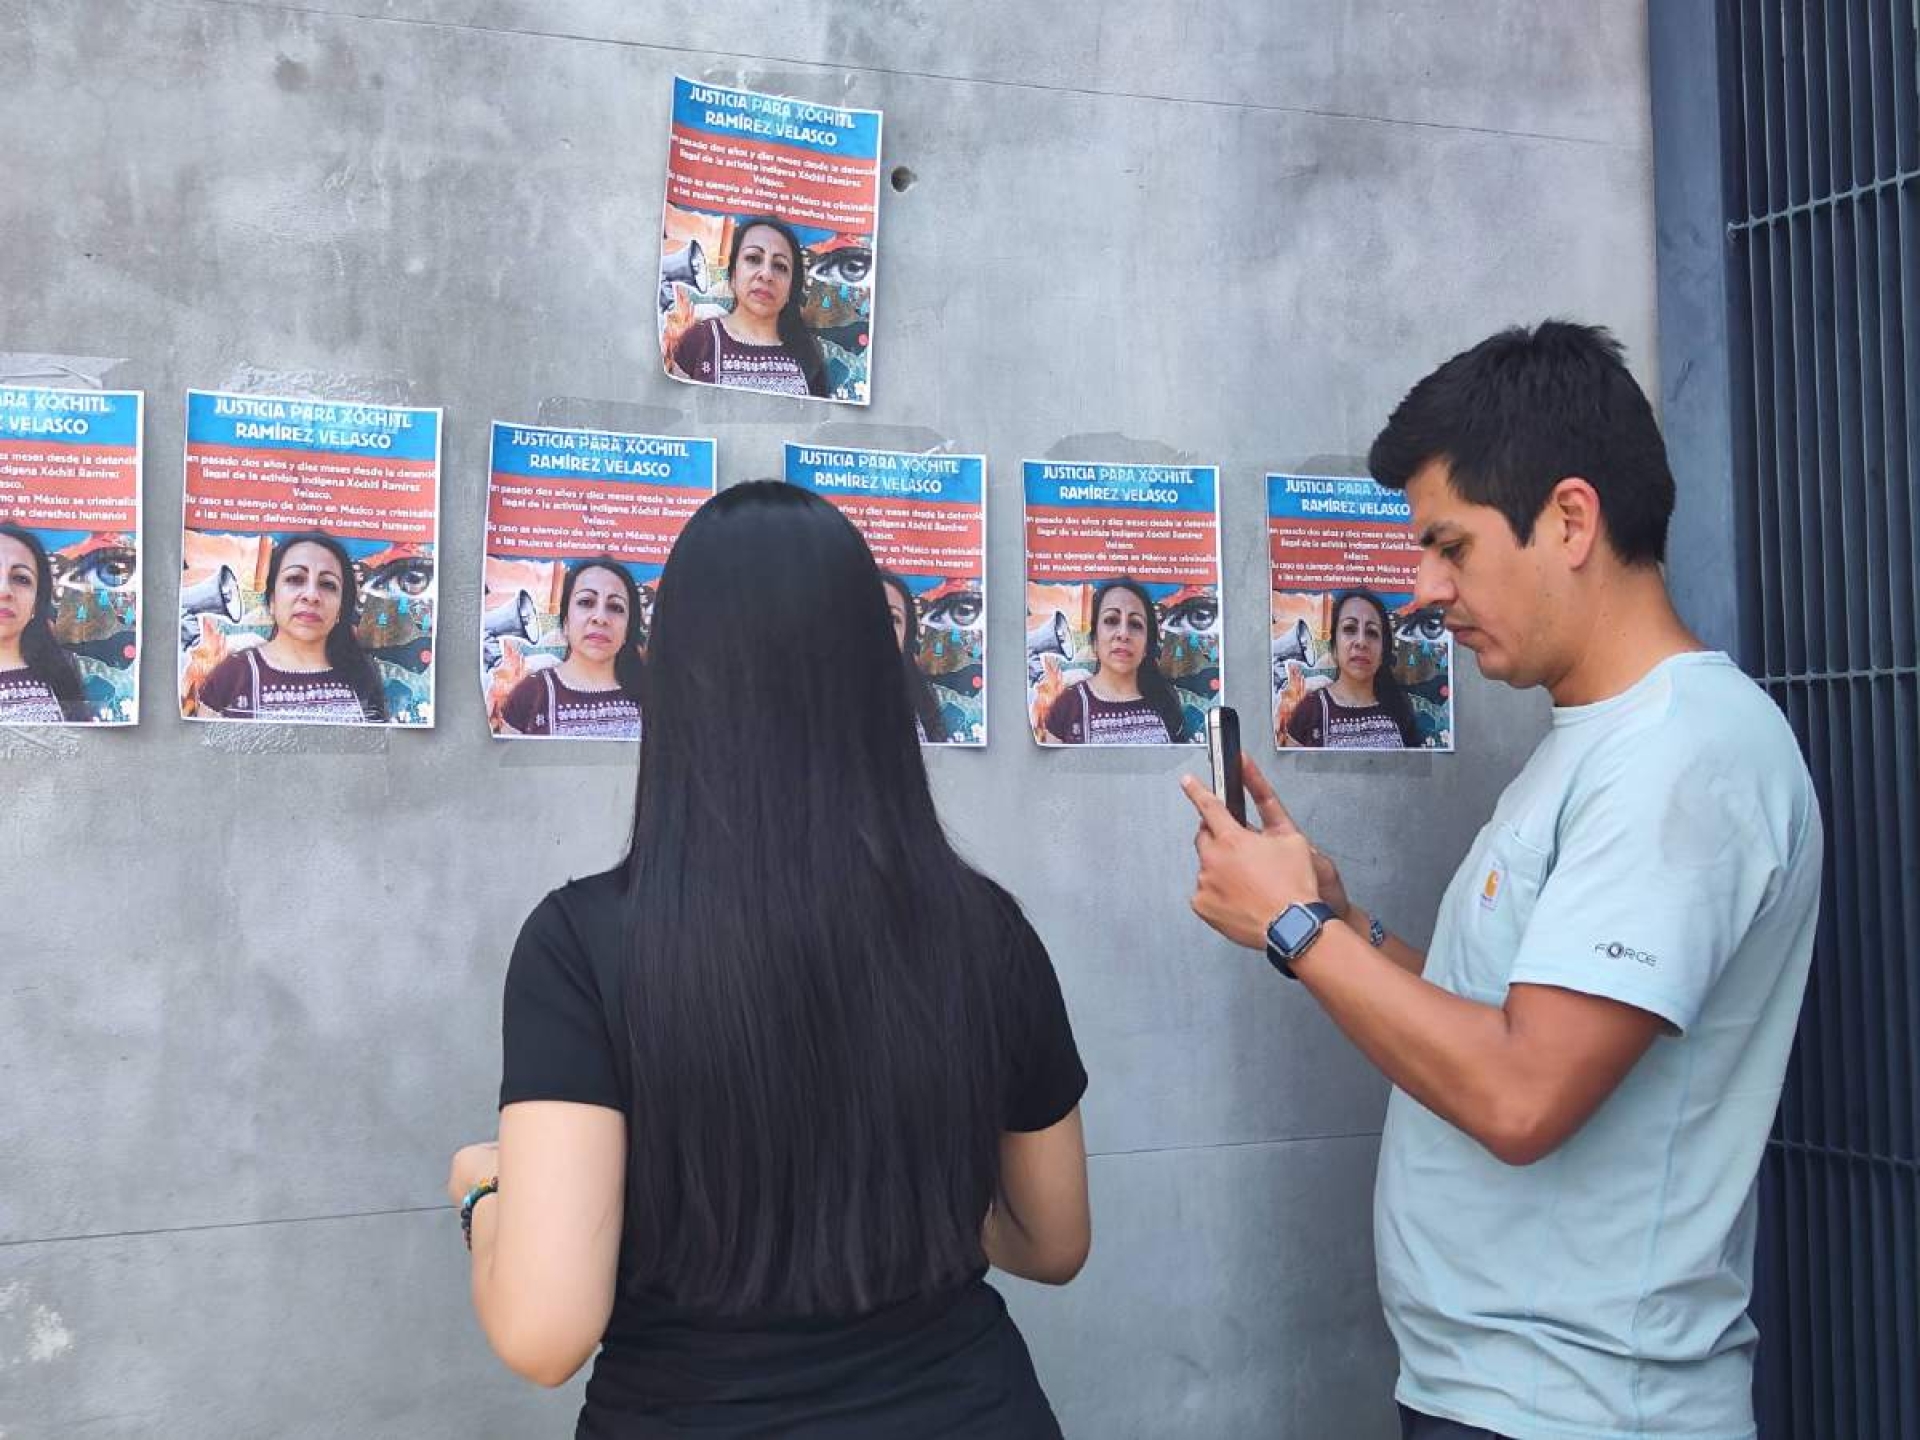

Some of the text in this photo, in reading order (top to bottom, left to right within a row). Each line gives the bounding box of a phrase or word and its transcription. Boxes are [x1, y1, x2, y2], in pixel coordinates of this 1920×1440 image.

[690, 85, 747, 109] JUSTICIA
[751, 98, 790, 118] PARA
[705, 111, 837, 146] RAMÍREZ VELASCO
[3, 390, 28, 407] RA
[215, 400, 284, 418] JUSTICIA
[290, 404, 337, 423] PARA
[9, 416, 89, 435] VELASCO
[236, 421, 391, 449] RAMÍREZ VELASCO
[512, 430, 574, 449] JUSTICIA
[578, 434, 622, 452] PARA
[530, 453, 671, 478] RAMÍREZ VELASCO
[799, 451, 854, 468] JUSTICIA
[859, 454, 896, 470] PARA
[815, 471, 941, 493] RAMÍREZ VELASCO
[1042, 465, 1096, 481] JUSTICIA
[1099, 468, 1135, 482] PARA
[1060, 484, 1178, 503] RAMÍREZ VELASCO
[1285, 479, 1334, 494] JUSTICIA
[1338, 482, 1371, 495] PARA
[1302, 497, 1411, 516] RAMÍREZ VELASCO
[1594, 941, 1657, 967] FORCE
